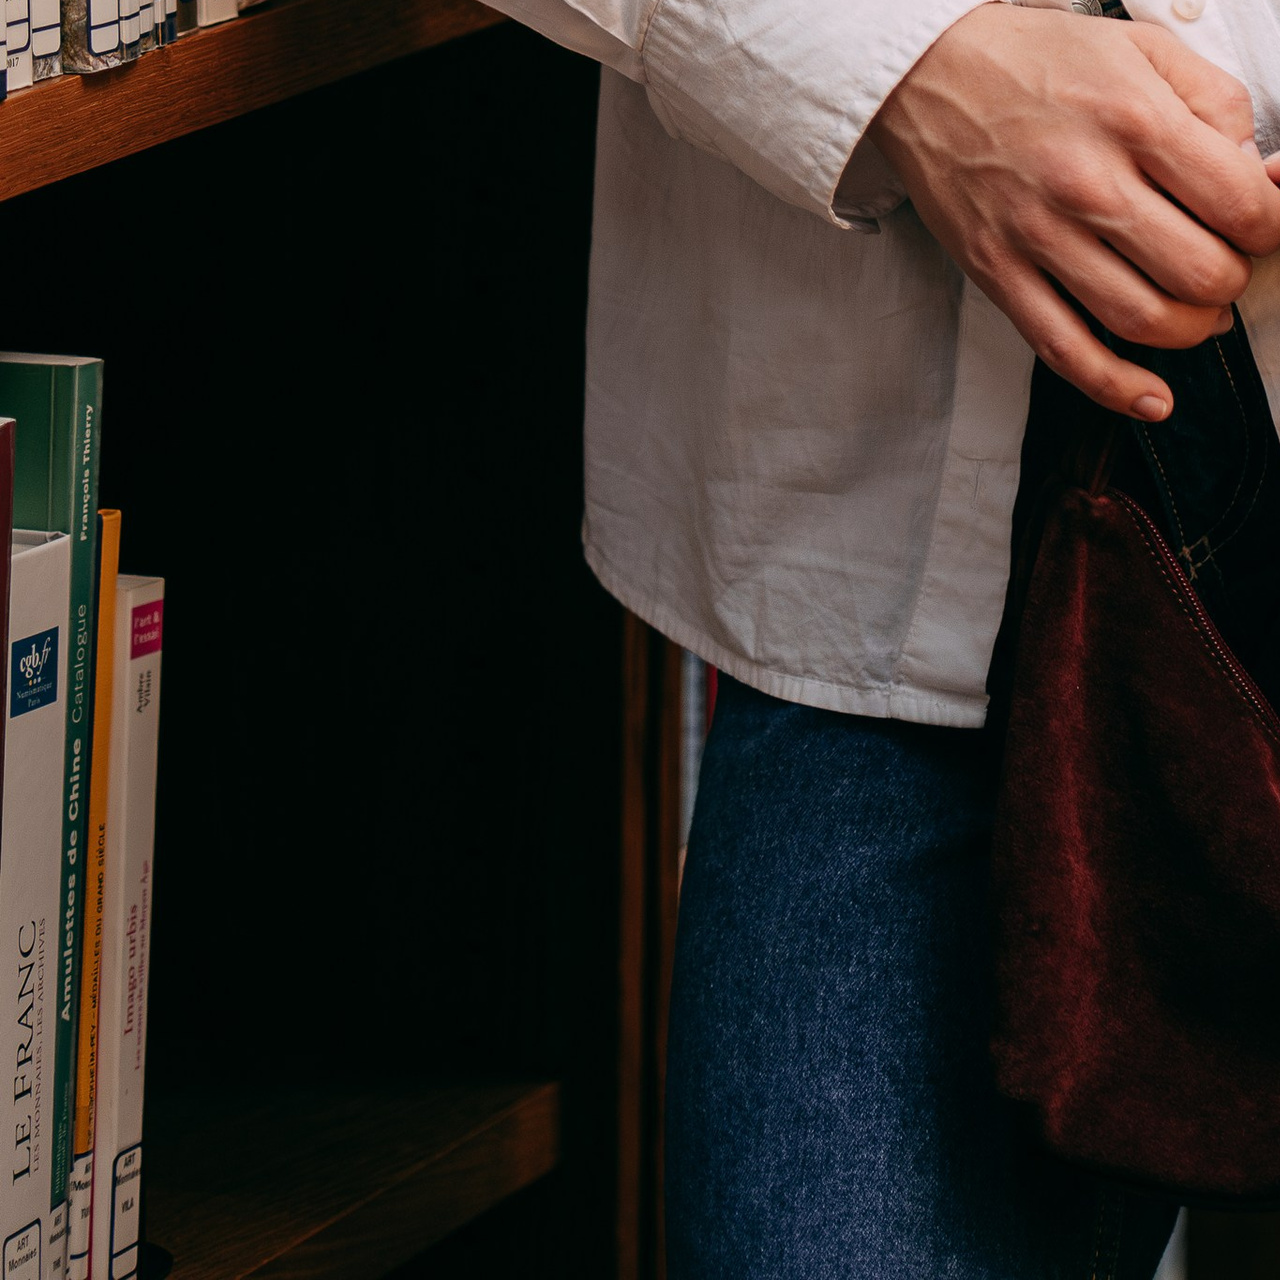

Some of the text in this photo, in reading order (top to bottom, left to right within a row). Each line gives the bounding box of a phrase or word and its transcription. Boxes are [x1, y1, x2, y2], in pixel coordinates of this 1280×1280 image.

[80, 404, 94, 541] François Thierry
[19, 636, 52, 679] cgb.fr
[61, 604, 88, 1022] Amulettes de Chine Catalogue
[37, 918, 45, 1001] ARCHIVES
[124, 904, 138, 1035] Imago urbis
[13, 921, 36, 1185] LE FRANC
[8, 1248, 37, 1271] Monnaies
[17, 1234, 29, 1252] ART
